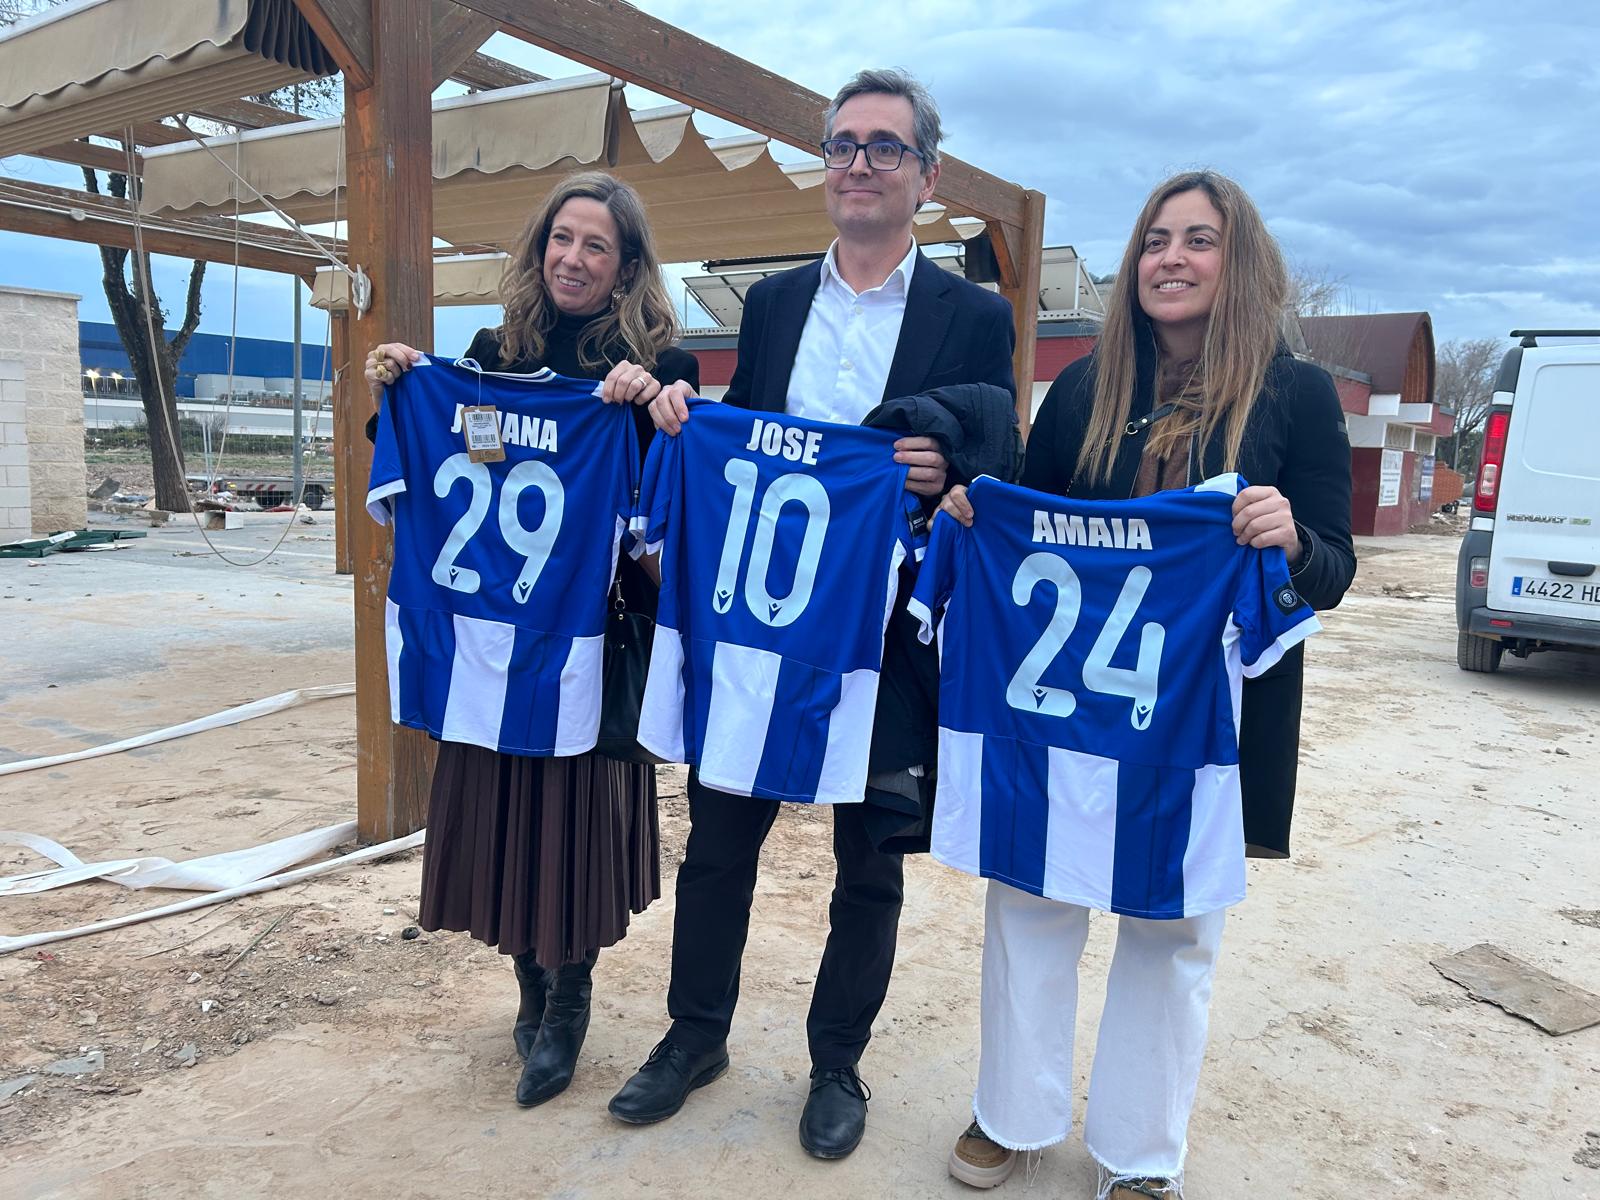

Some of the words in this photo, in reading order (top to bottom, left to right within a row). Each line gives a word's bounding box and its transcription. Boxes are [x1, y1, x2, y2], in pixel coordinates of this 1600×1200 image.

[450, 402, 558, 453] JANA
[746, 418, 823, 466] JOSE
[431, 452, 565, 604] 29
[712, 457, 831, 628] 10
[1032, 509, 1153, 550] AMAIA
[1506, 513, 1567, 524] RENAULT
[1525, 580, 1574, 599] 4422
[1006, 551, 1166, 731] 24
